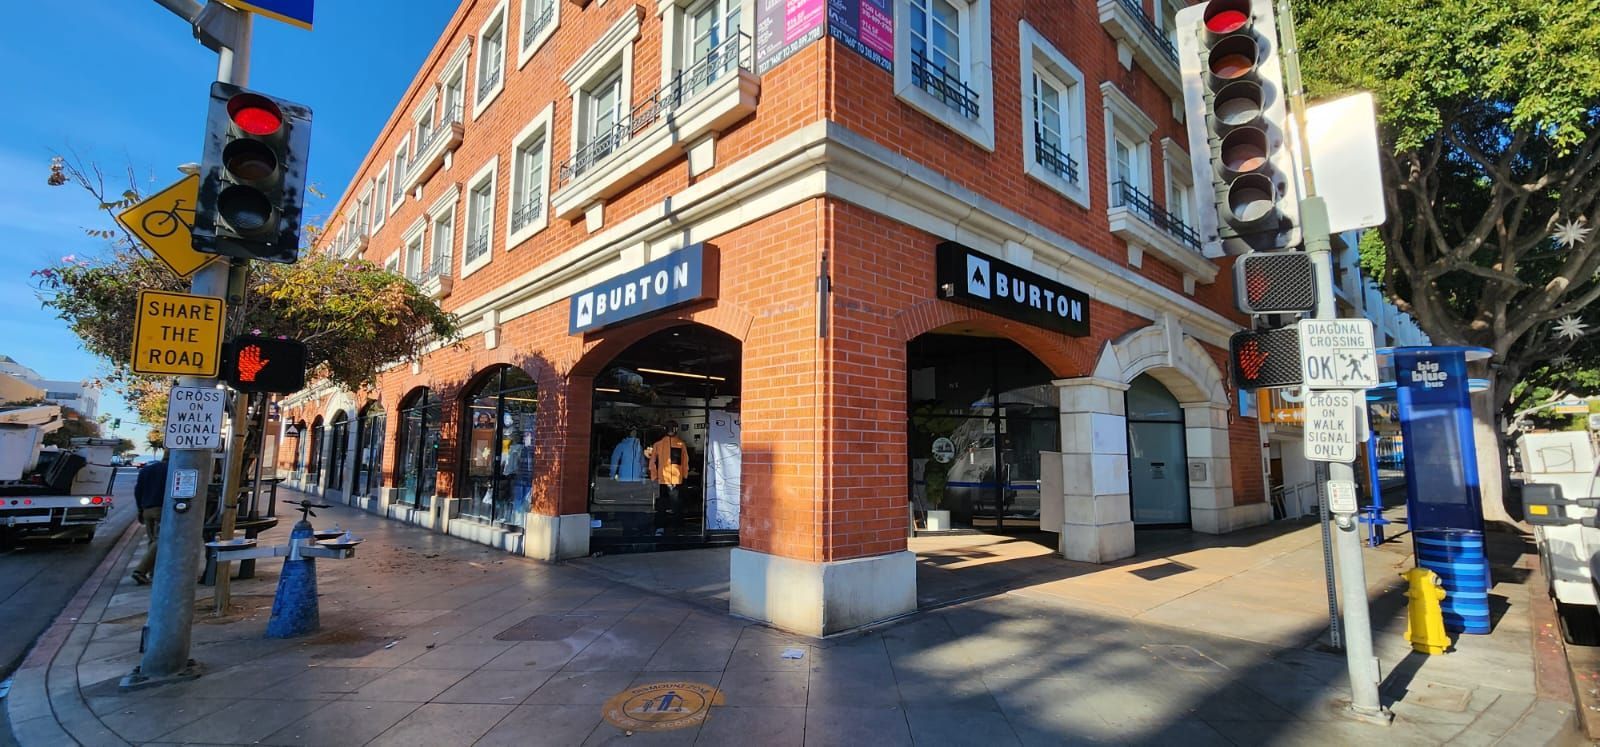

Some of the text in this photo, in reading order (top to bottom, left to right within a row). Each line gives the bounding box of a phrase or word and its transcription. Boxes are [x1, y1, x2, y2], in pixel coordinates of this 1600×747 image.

[830, 25, 842, 40] TEXT
[857, 42, 864, 54] TO
[596, 262, 688, 316] BURTON
[996, 271, 1082, 322] BURTON
[148, 301, 214, 321] SHARE
[161, 326, 200, 343] THE
[1308, 324, 1364, 335] DIAGONAL
[1310, 336, 1365, 347] CROSSING
[149, 349, 204, 369] ROAD
[1307, 355, 1334, 380] OK
[1417, 361, 1439, 372] big
[1411, 370, 1448, 382] blue
[176, 390, 220, 401] CROSS
[189, 402, 204, 411] ON
[1310, 396, 1349, 407] CROSS
[177, 413, 213, 422] WALK
[1322, 409, 1335, 418] ON
[169, 424, 218, 435] SIGNAL
[1313, 420, 1345, 431] WALK
[175, 436, 211, 446] ONLY
[1308, 432, 1352, 444] SIGNAL
[1314, 444, 1344, 456] ONLY
